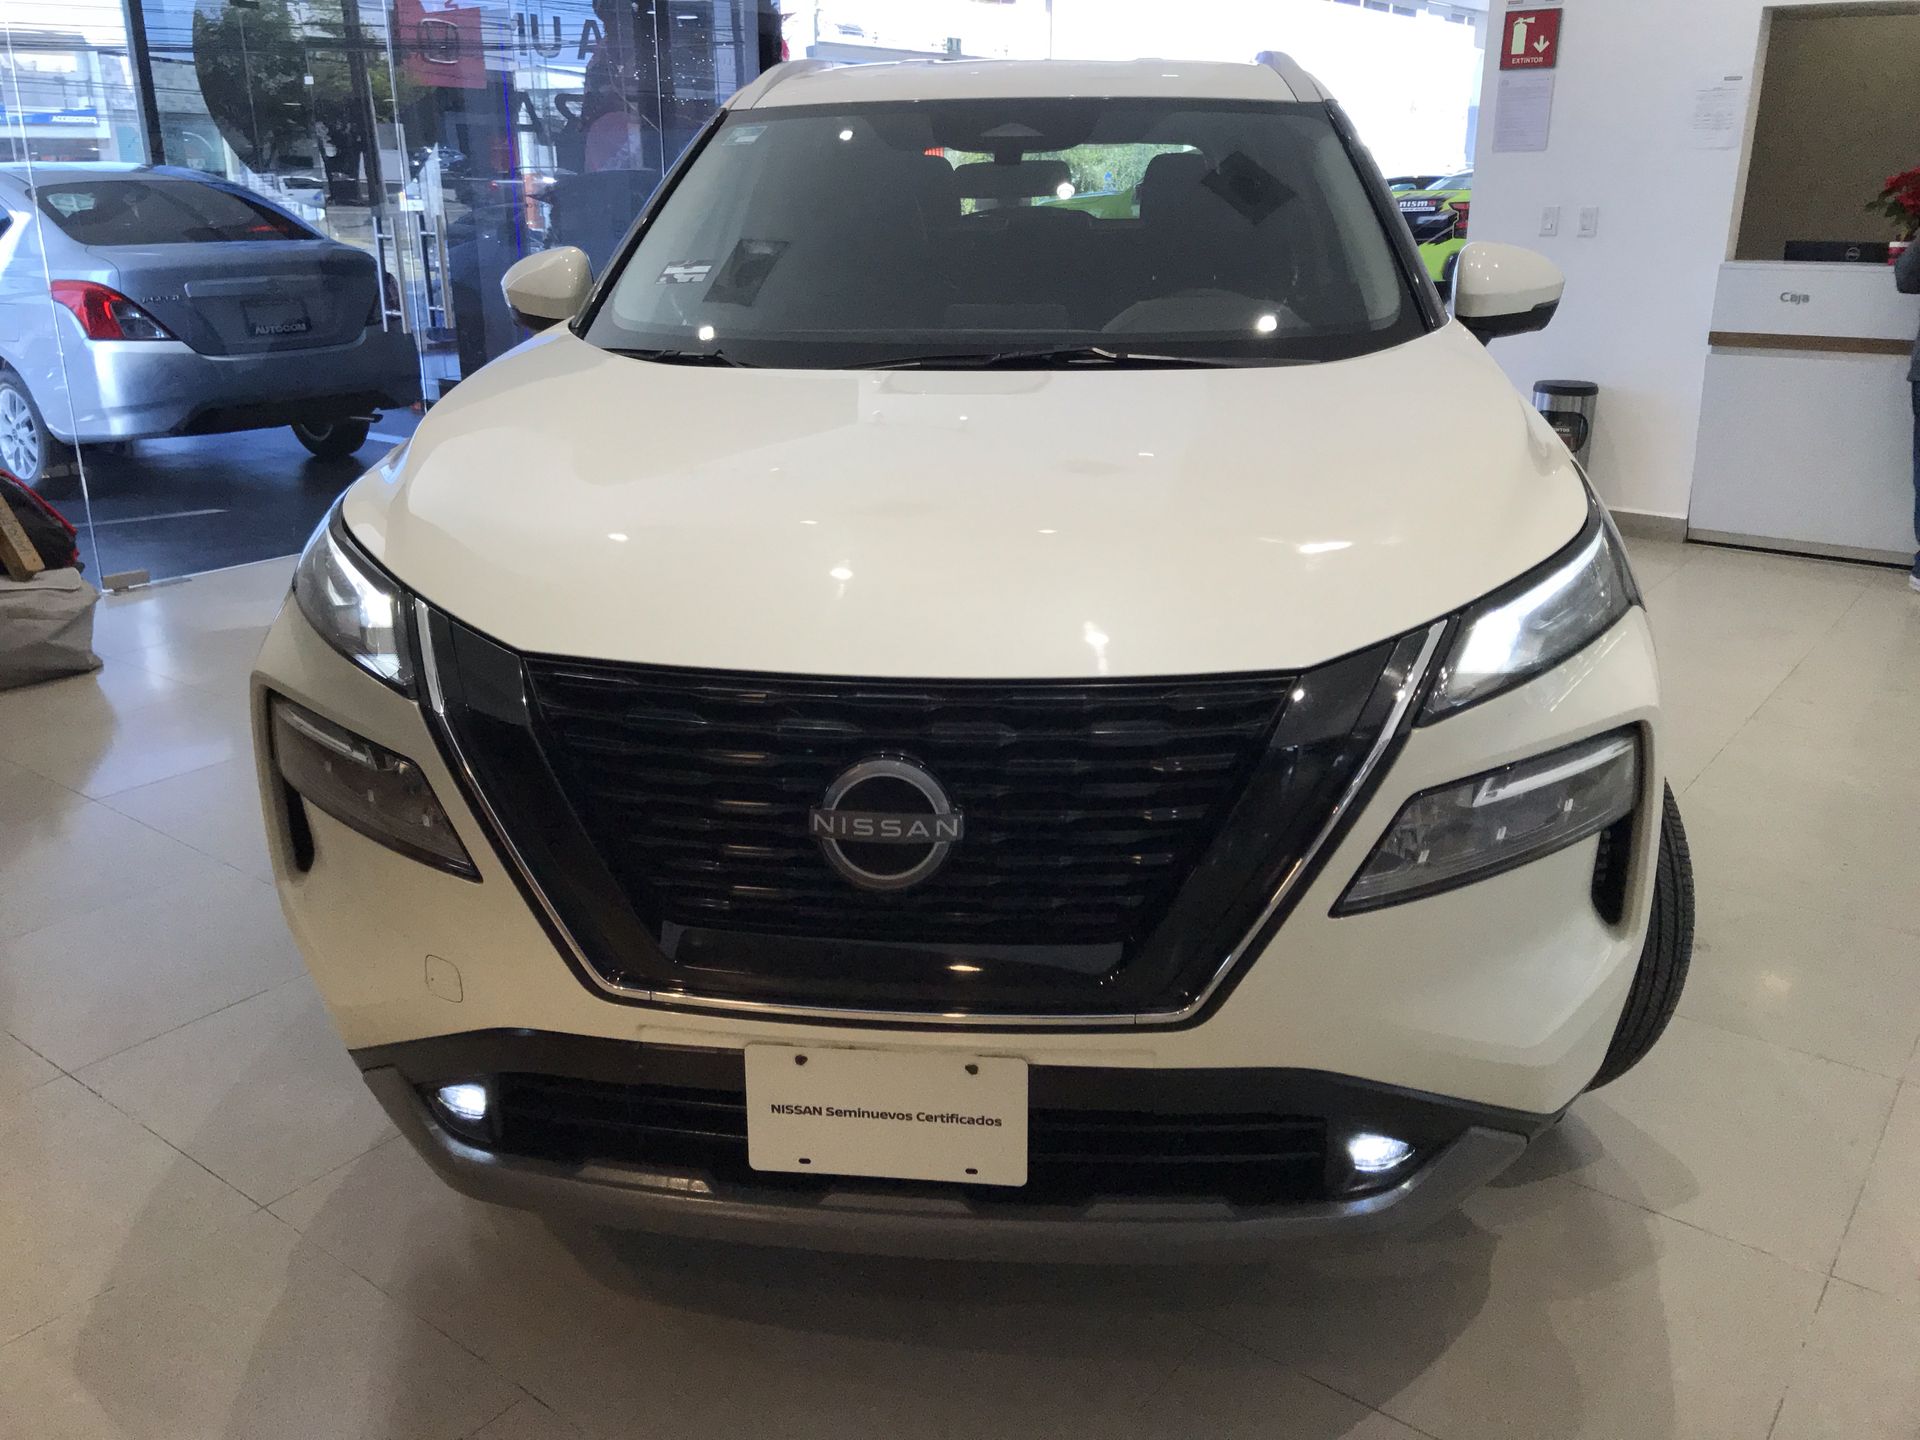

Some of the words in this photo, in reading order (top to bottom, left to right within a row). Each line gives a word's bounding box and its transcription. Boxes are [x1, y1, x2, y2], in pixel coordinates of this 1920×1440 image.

[1511, 57, 1544, 65] EXTINTOR
[1780, 292, 1810, 305] Caja
[813, 813, 958, 838] NISSAN
[770, 1103, 823, 1117] NISSAN
[825, 1106, 913, 1122] Seminuevos
[916, 1111, 1003, 1128] Certificados
